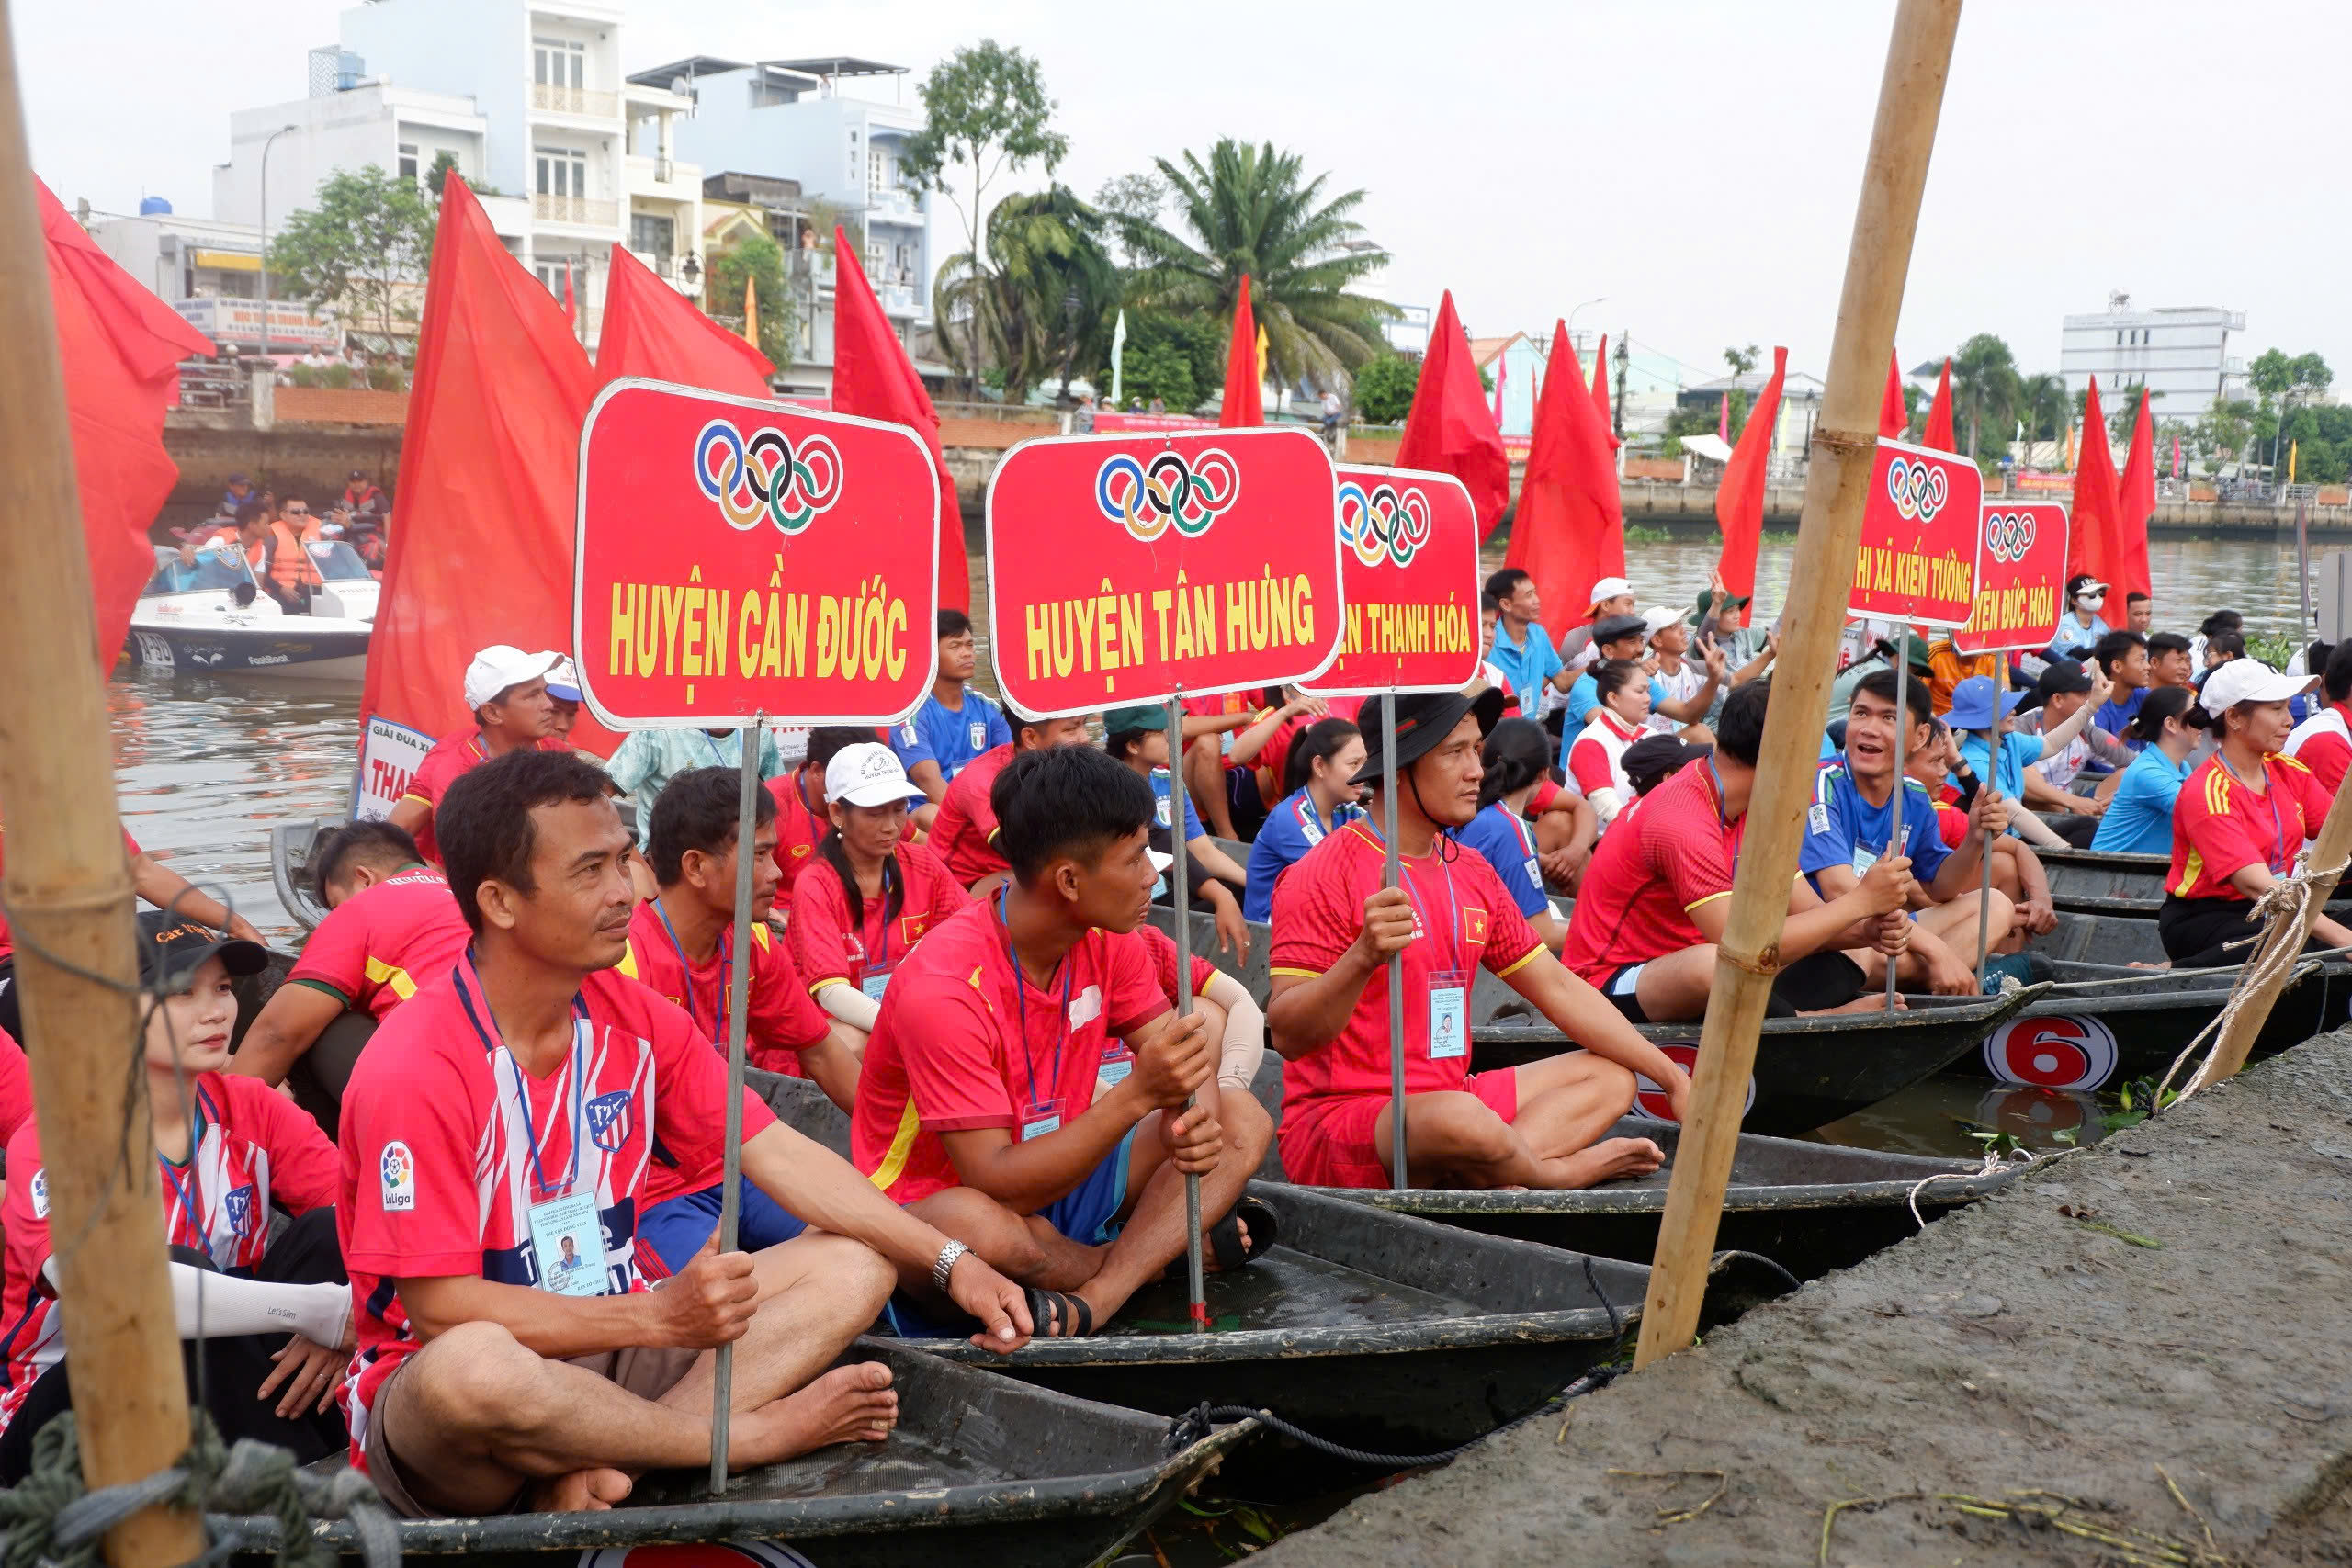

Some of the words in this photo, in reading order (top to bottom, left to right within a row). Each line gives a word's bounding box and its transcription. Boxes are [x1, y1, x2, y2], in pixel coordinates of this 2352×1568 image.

[1851, 546, 1872, 603] HỊ
[1873, 536, 1892, 592] XÃ
[1895, 536, 1928, 597] KIẾN
[1931, 548, 1972, 604] TƯỜNG
[2002, 577, 2026, 629] ĐỨC
[2028, 575, 2053, 626] HÒA
[610, 565, 729, 705] HUYỆN
[738, 553, 808, 679] CẦN
[817, 574, 908, 682] ĐƯỚC
[1025, 577, 1144, 693] HUYỆN
[1152, 569, 1216, 662] TÂN
[1226, 562, 1315, 653] HƯNG
[1367, 604, 1430, 669] THẠNH
[1434, 591, 1471, 654] HÓA
[373, 725, 393, 739] GIẢI
[396, 732, 417, 749] ĐUA
[2006, 1015, 2092, 1087] 6
[386, 1192, 411, 1206] LaLiga
